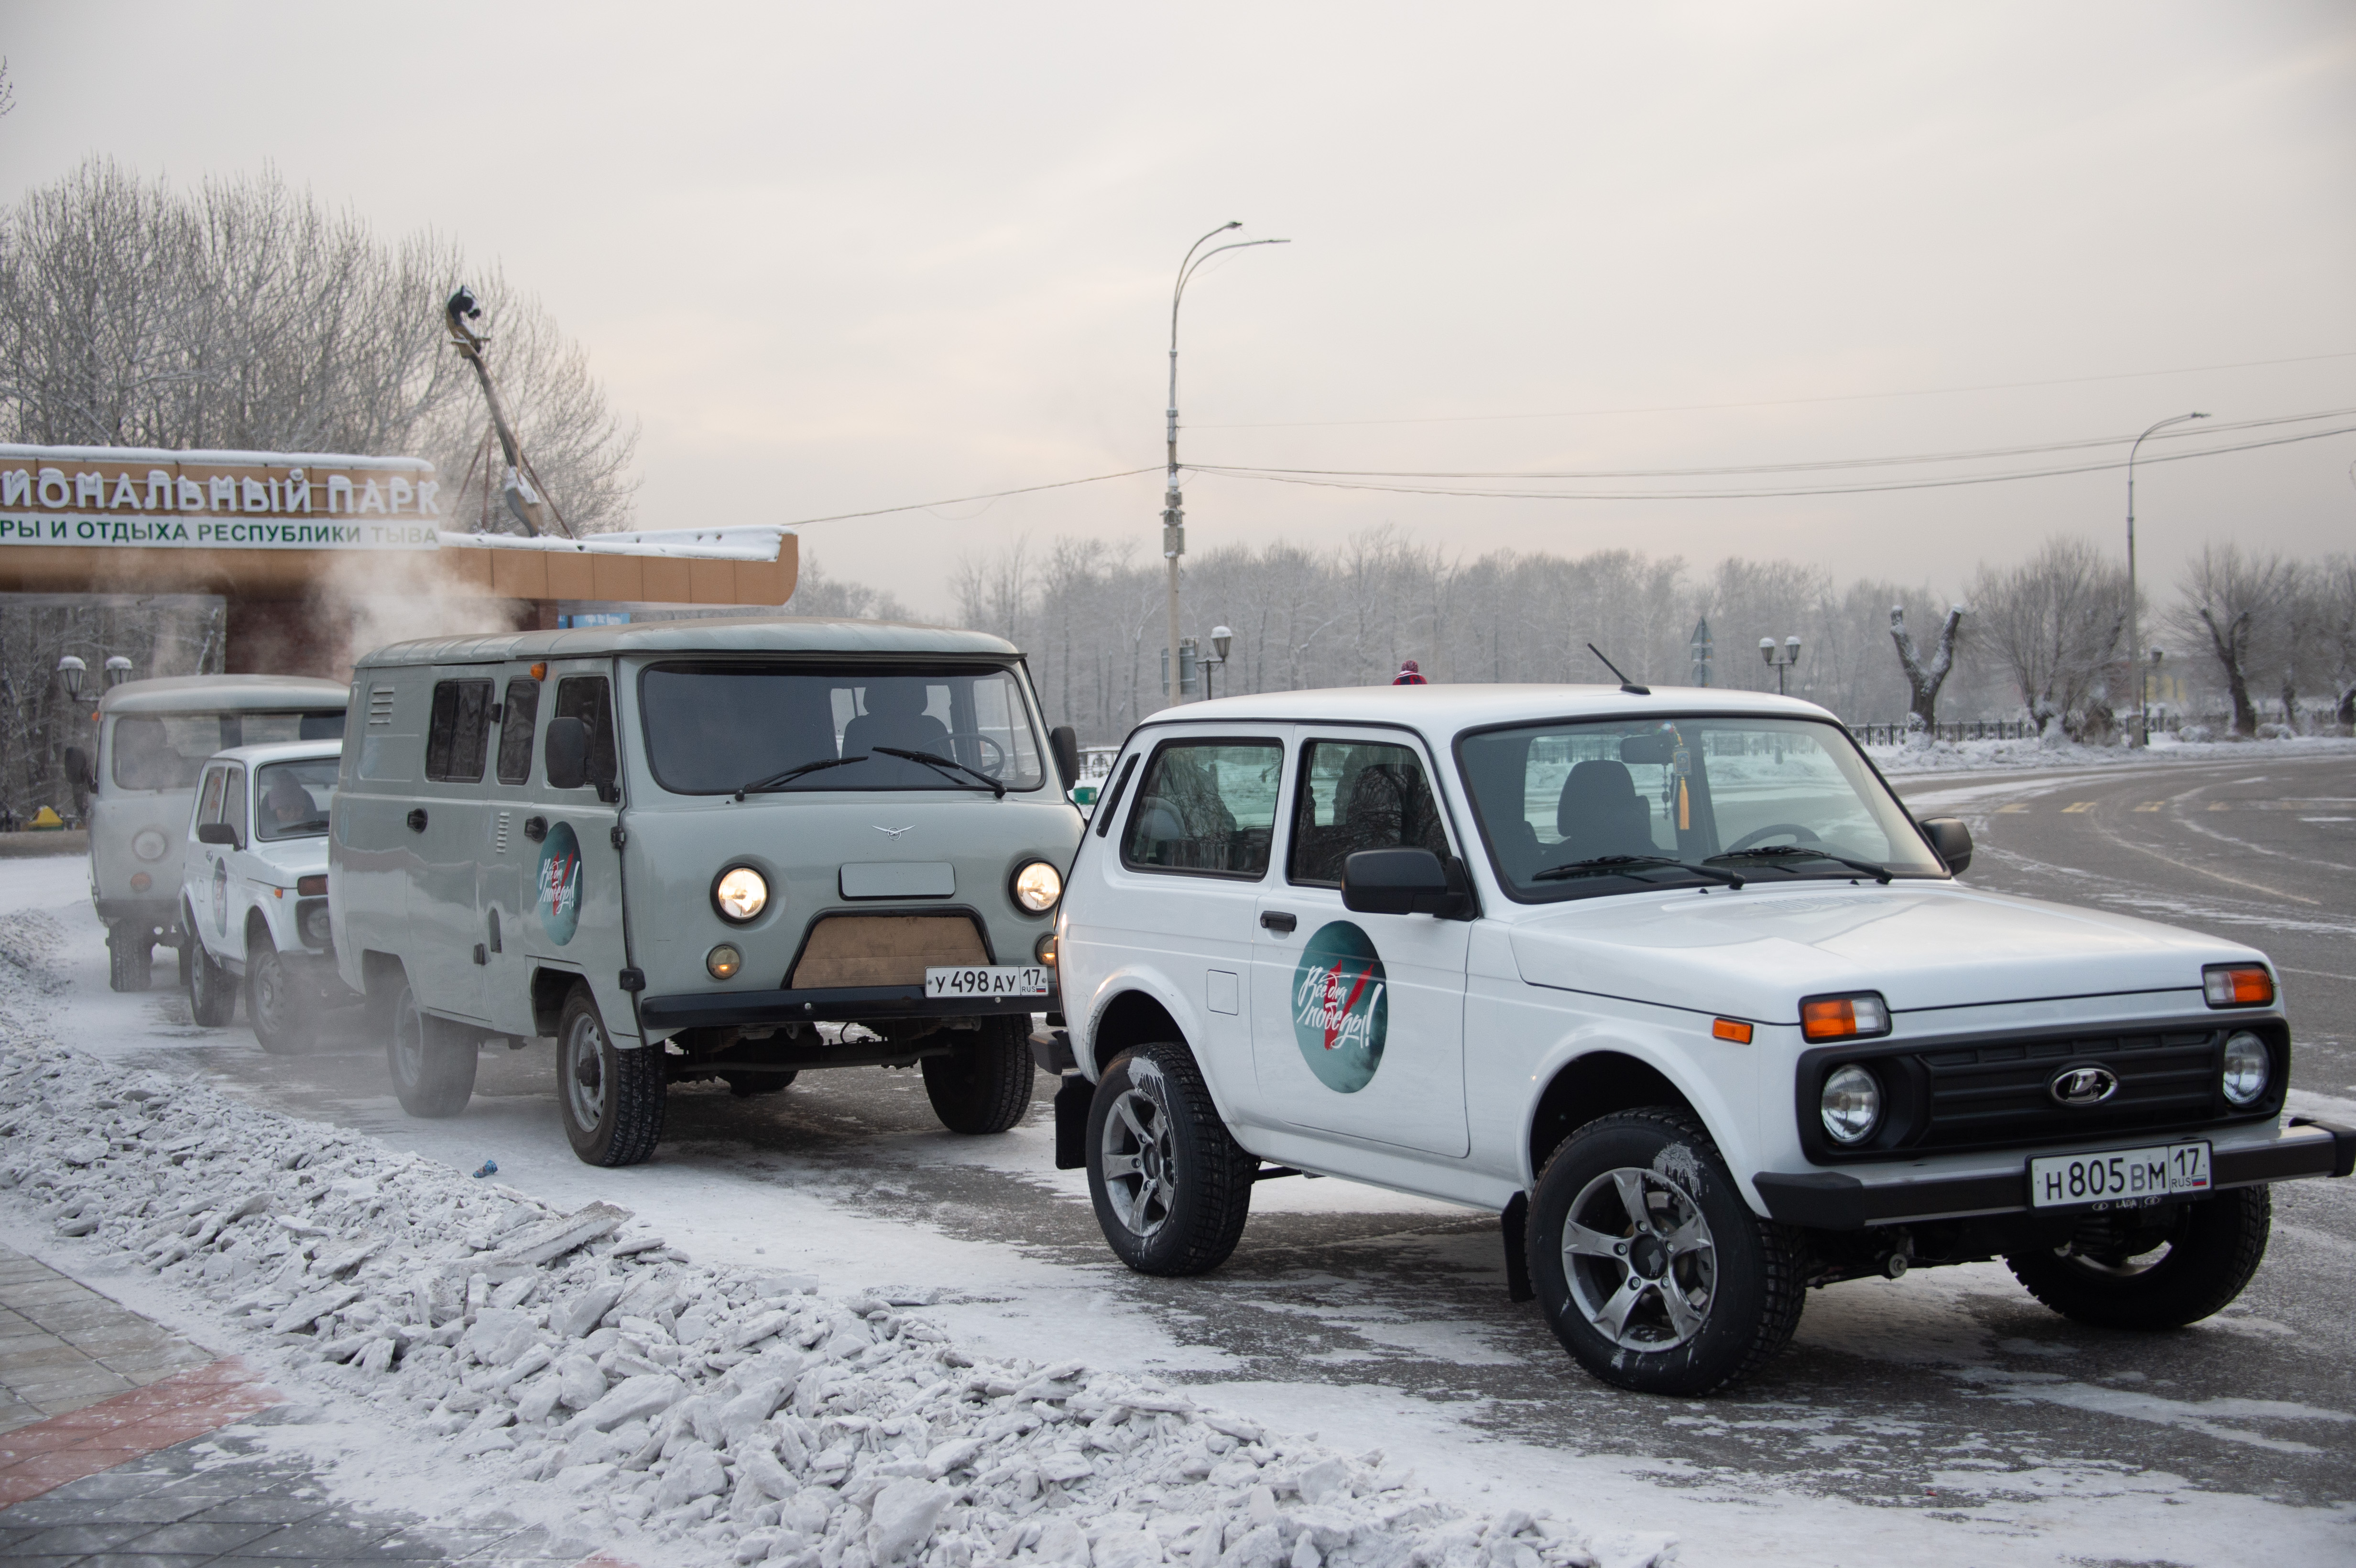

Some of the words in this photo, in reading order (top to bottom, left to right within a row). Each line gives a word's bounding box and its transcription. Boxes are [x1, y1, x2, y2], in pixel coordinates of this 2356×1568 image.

[1, 467, 311, 513] ИОНАЛЬНЫЙ
[328, 474, 440, 514] ПАРК
[0, 520, 41, 538] РЫ
[51, 521, 67, 538] И
[76, 522, 190, 543] ОТДЫХА
[198, 524, 360, 543] РЕСПУБЛИКИ
[371, 527, 439, 544] ТЫВА
[1023, 969, 1040, 986] 17
[2174, 1147, 2199, 1176] 17
[2171, 1177, 2191, 1188] RUS
